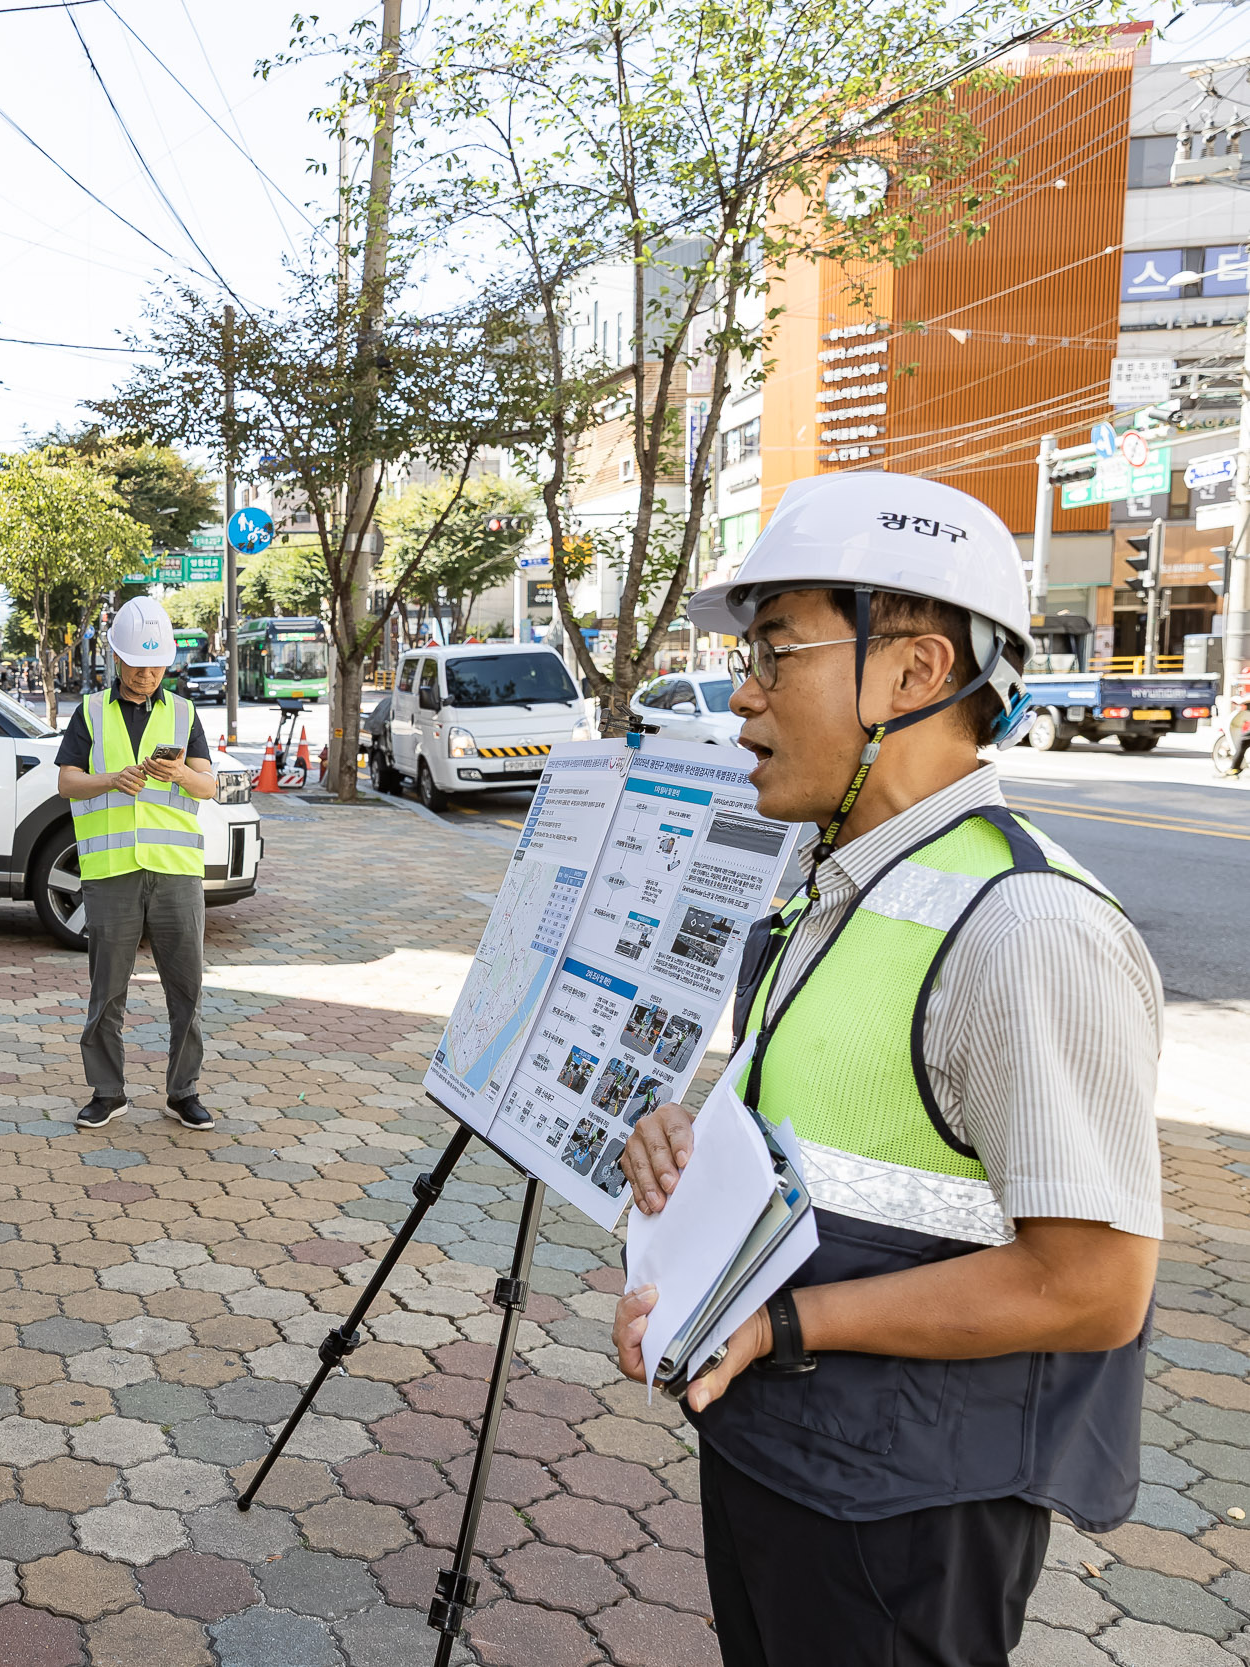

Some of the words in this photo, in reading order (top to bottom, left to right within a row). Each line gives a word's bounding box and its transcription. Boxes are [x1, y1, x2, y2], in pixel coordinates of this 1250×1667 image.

[876, 512, 969, 543] 광진구
[822, 821, 840, 845] SAFETY
[851, 764, 869, 789] SAFETY
